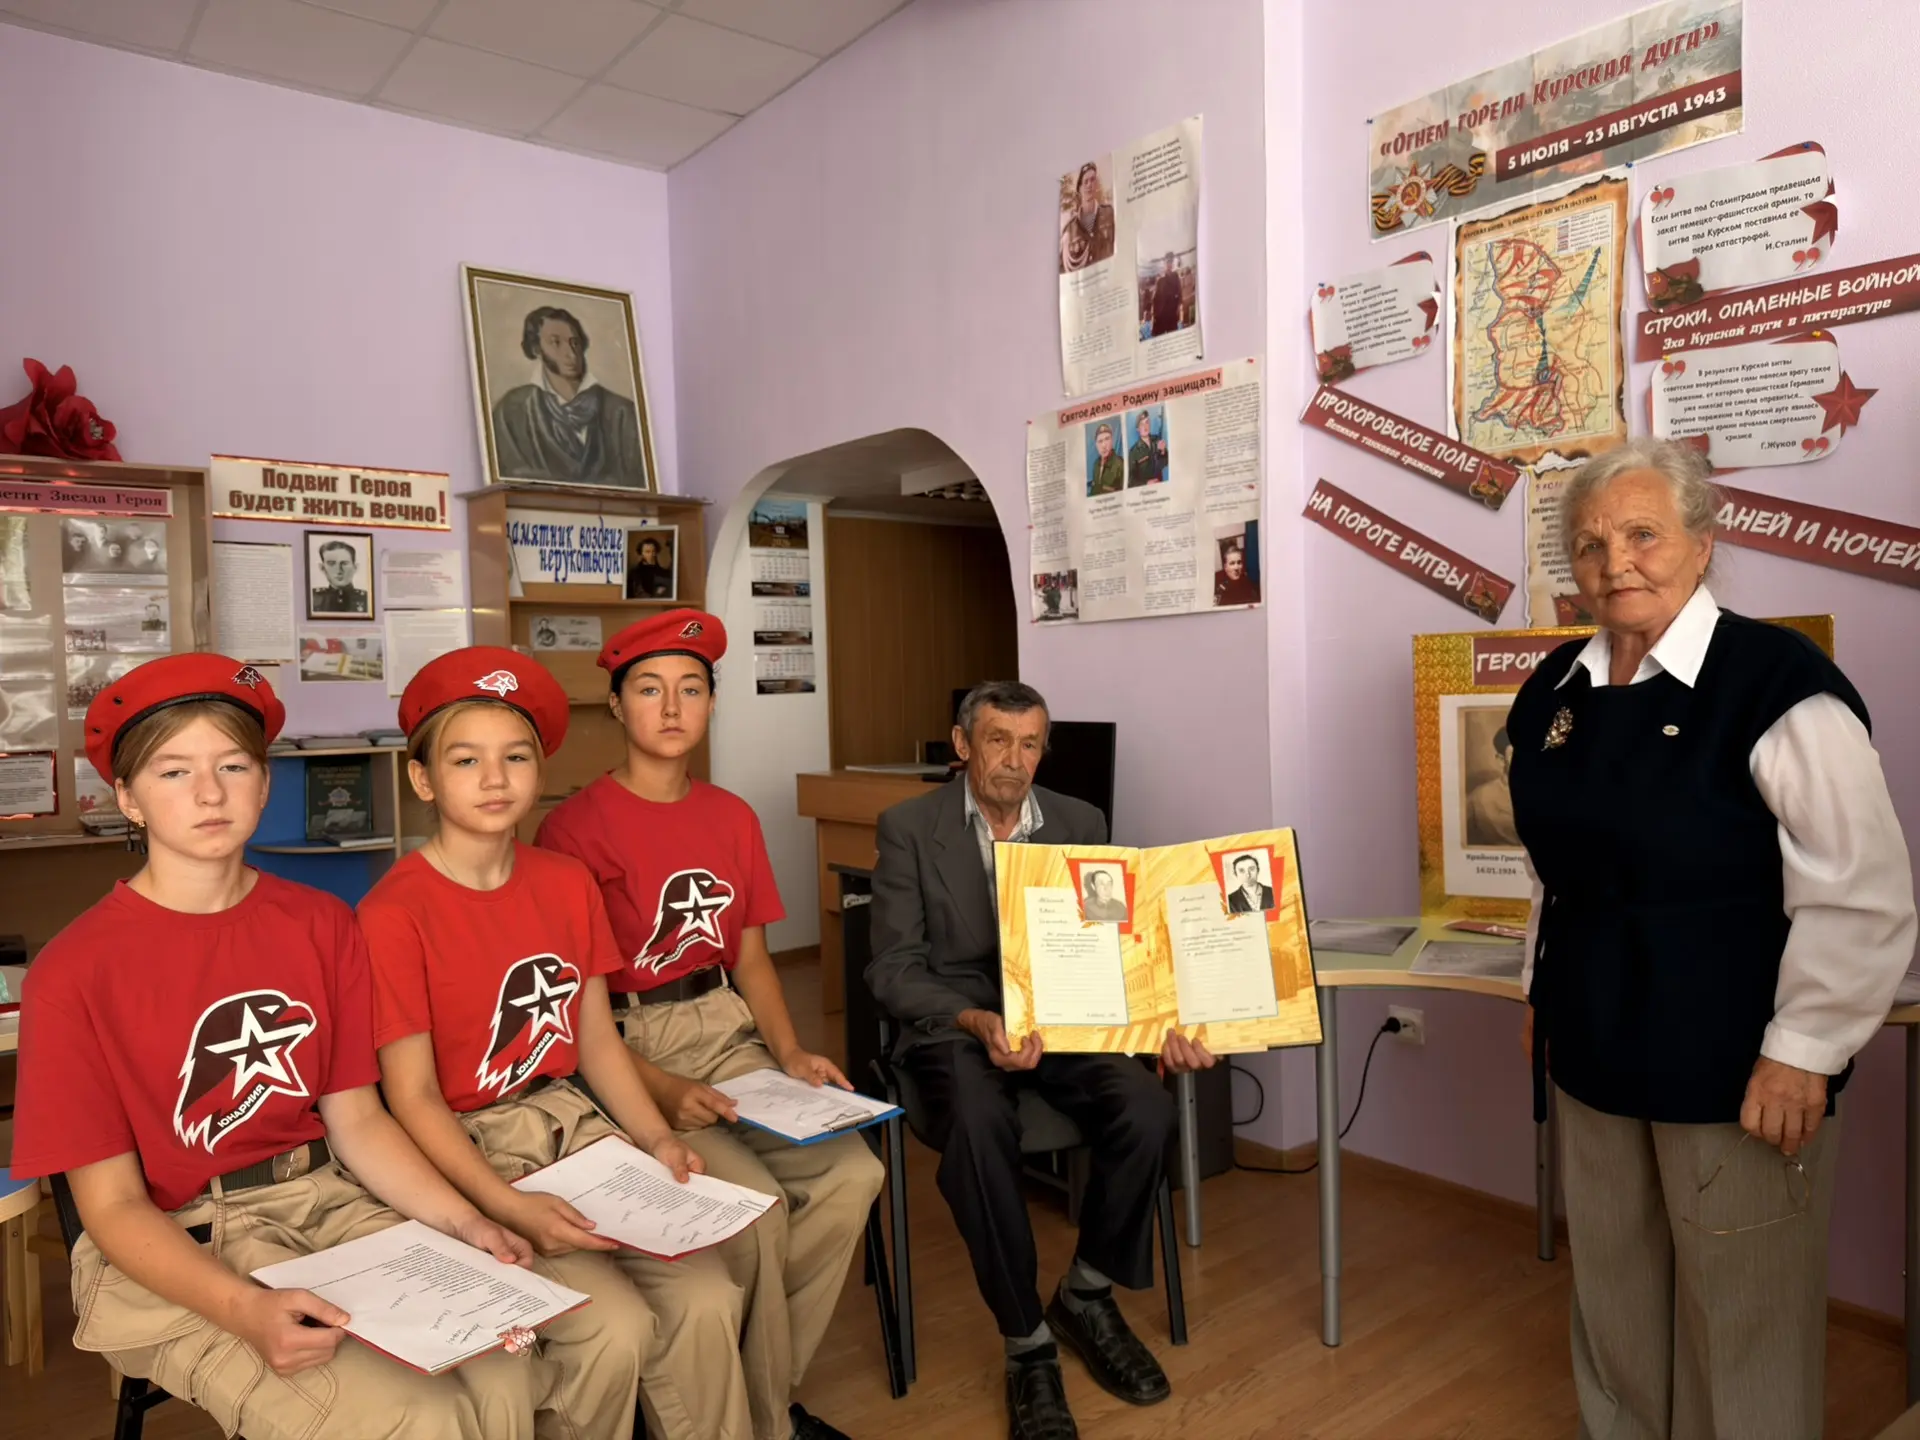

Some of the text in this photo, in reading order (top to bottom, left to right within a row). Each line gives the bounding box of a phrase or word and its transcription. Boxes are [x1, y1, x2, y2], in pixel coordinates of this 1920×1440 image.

[1507, 156, 1516, 170] 5
[1520, 139, 1569, 167] ИЮЛЯ
[1585, 127, 1604, 146] 23
[1608, 103, 1679, 139] АВГУСТА
[1683, 87, 1727, 112] 1943
[1650, 214, 1669, 224] Если
[1694, 204, 1708, 213] под
[1709, 189, 1767, 208] Сталинградом
[1769, 175, 1821, 195] предвещала
[1656, 225, 1678, 236] закат
[1680, 202, 1769, 230] немецко-фашистской
[1804, 191, 1814, 200] то
[1692, 232, 1705, 241] под
[1707, 224, 1742, 237] Курском
[1744, 212, 1787, 228] поставила
[1789, 210, 1800, 218] ее
[1692, 230, 1771, 255] перед катастрофой.
[1765, 236, 1808, 251] И.Сталин
[1643, 263, 1920, 335] СТРОКИ, ОПАЛЕННЫЕ ВОЙНОЙ
[1662, 298, 1892, 350] Эхо Курской дуги в литературе
[1663, 383, 1694, 393] советские
[1789, 368, 1808, 378] врагу
[1810, 365, 1831, 374] такое
[1704, 366, 1740, 378] результате
[1740, 361, 1769, 372] Курской
[1745, 382, 1789, 394] фашистская
[1789, 378, 1825, 389] Германия
[1060, 409, 1089, 425] Святое
[1090, 402, 1113, 418] дело
[1122, 389, 1160, 407] Родину
[1163, 371, 1221, 397] защищать!
[1683, 405, 1696, 413] уже
[1744, 407, 1774, 417] Курской
[1315, 391, 1480, 474] ПРОХОРОВСКОЕ ПОЛЕ
[1769, 414, 1817, 425] смертельного
[1760, 440, 1797, 450] Г.Жуков
[50, 489, 106, 504] Звезда
[116, 493, 162, 508] Героя
[261, 467, 412, 499] Подвиг Героя
[228, 490, 447, 525] будет жить вечно!
[579, 514, 623, 551] воздвиг
[1308, 490, 1471, 591] НА ПОРОГЕ БИТВЫ
[1715, 501, 1920, 572] ДНЕЙ И НОЧЕЙ
[515, 1031, 553, 1076] ЮНАРМИЯ
[216, 1083, 266, 1128] ЮНАРМИЯ
